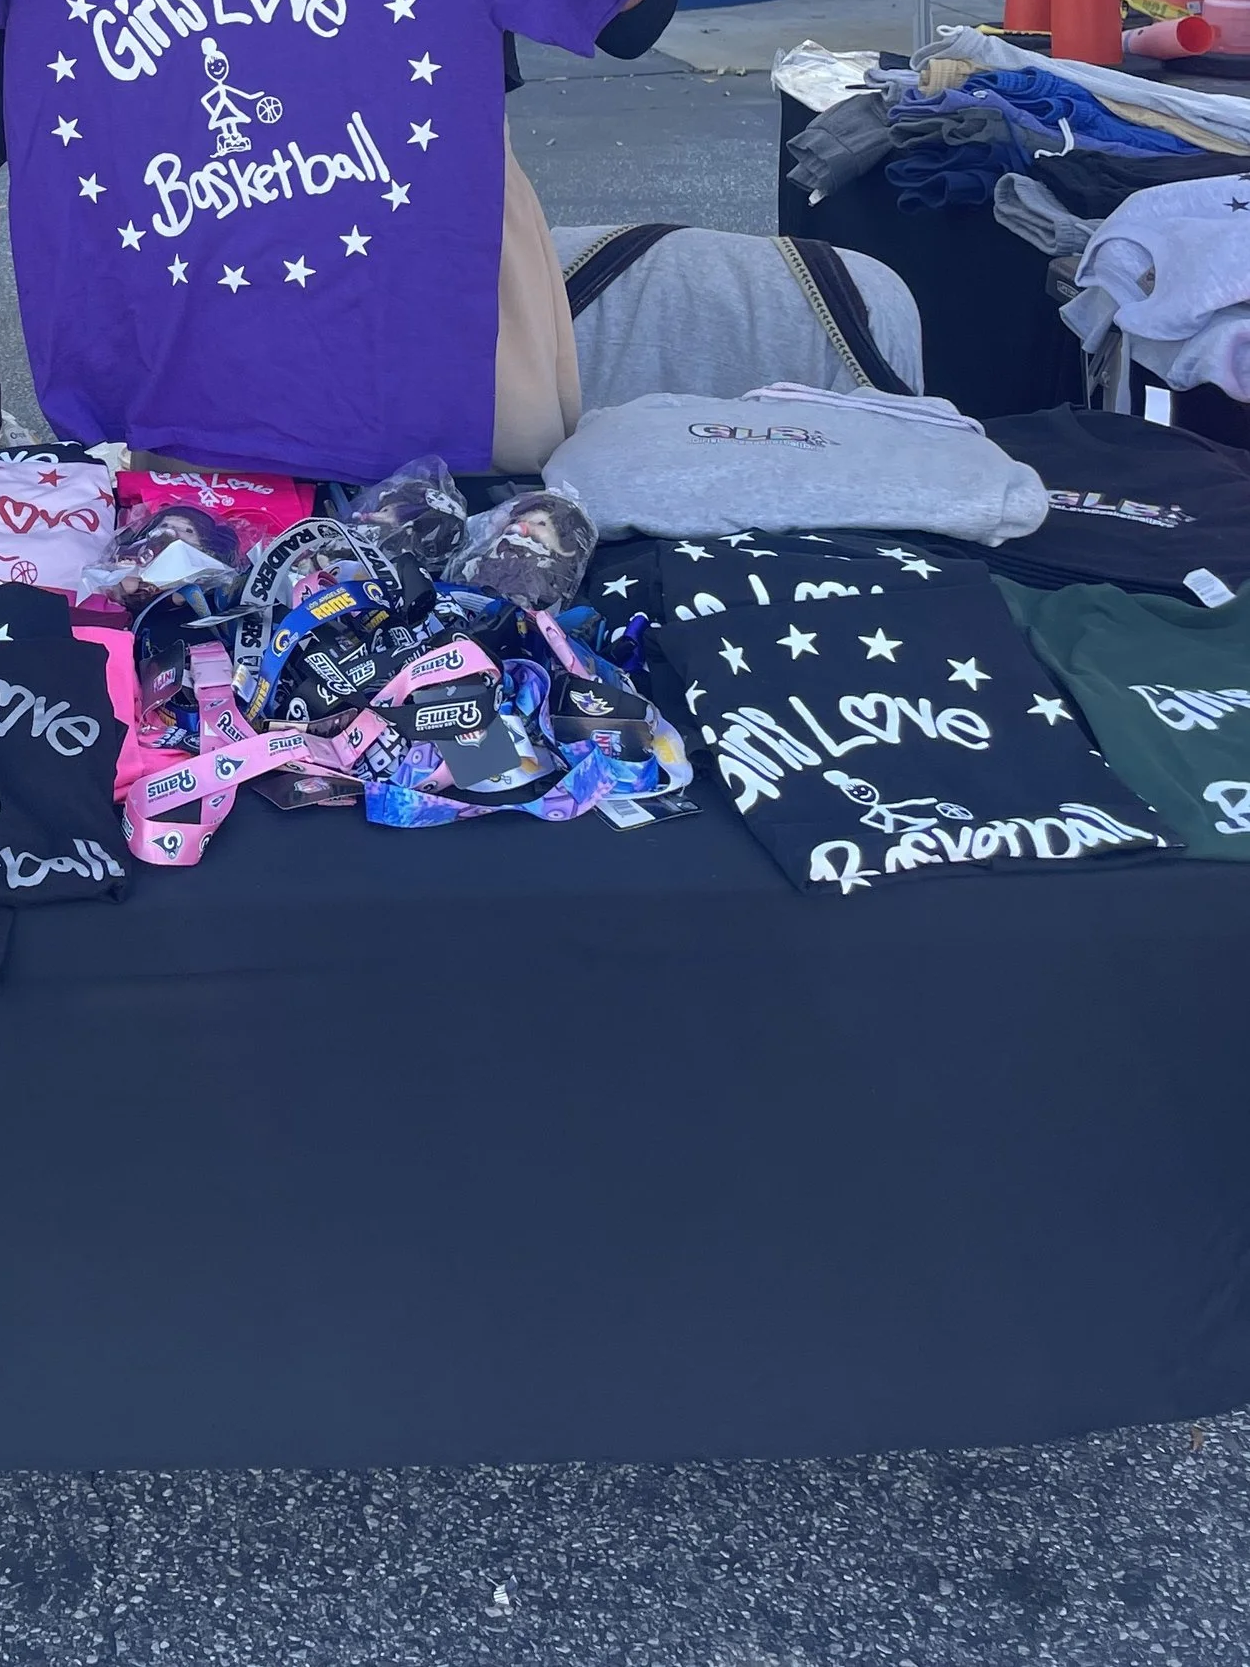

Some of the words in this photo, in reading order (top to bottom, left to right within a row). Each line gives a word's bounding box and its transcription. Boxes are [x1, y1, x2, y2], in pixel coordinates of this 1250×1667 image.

[143, 112, 391, 237] Basketball
[688, 423, 810, 442] GLB
[1047, 489, 1162, 518] GLB
[251, 527, 317, 602] RAIDERS
[311, 593, 357, 620] RAMS
[305, 652, 357, 695] Rams
[411, 649, 464, 674] Rams
[216, 710, 247, 743] Ram
[416, 701, 481, 729] Rams
[788, 692, 993, 757] Love
[268, 735, 304, 752] ams
[146, 769, 197, 799] Rams
